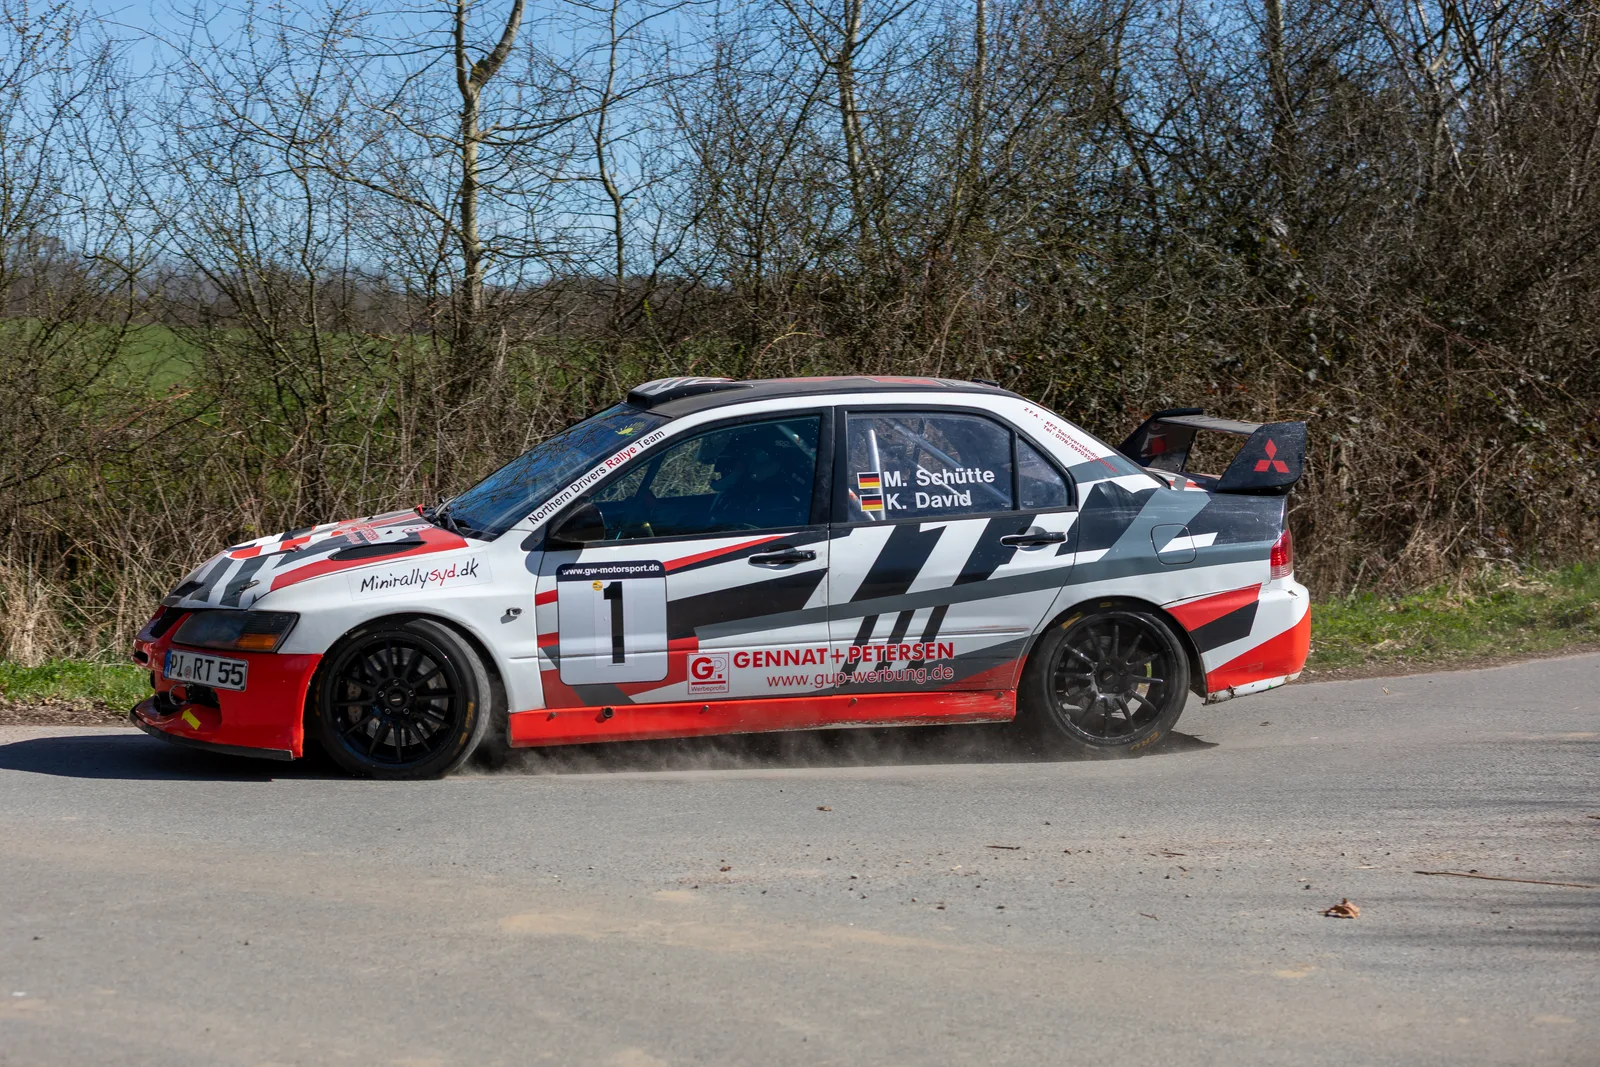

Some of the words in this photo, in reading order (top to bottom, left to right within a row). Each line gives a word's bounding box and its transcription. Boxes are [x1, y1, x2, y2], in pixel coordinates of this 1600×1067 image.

[527, 490, 573, 525] Northern
[570, 464, 607, 494] Drivers
[605, 445, 637, 469] Rallye
[635, 429, 666, 449] Team
[883, 471, 907, 487] M.
[916, 468, 996, 487] Schütte
[886, 494, 907, 510] K.
[915, 490, 973, 509] David
[360, 557, 479, 592] Minirallysyd.dk
[561, 564, 660, 576] www.gw-motorsport.de
[603, 581, 625, 664] 1
[169, 654, 185, 677] PI
[193, 657, 215, 681] RT
[217, 661, 244, 686] 55
[766, 664, 954, 689] www.gup-werbung.de
